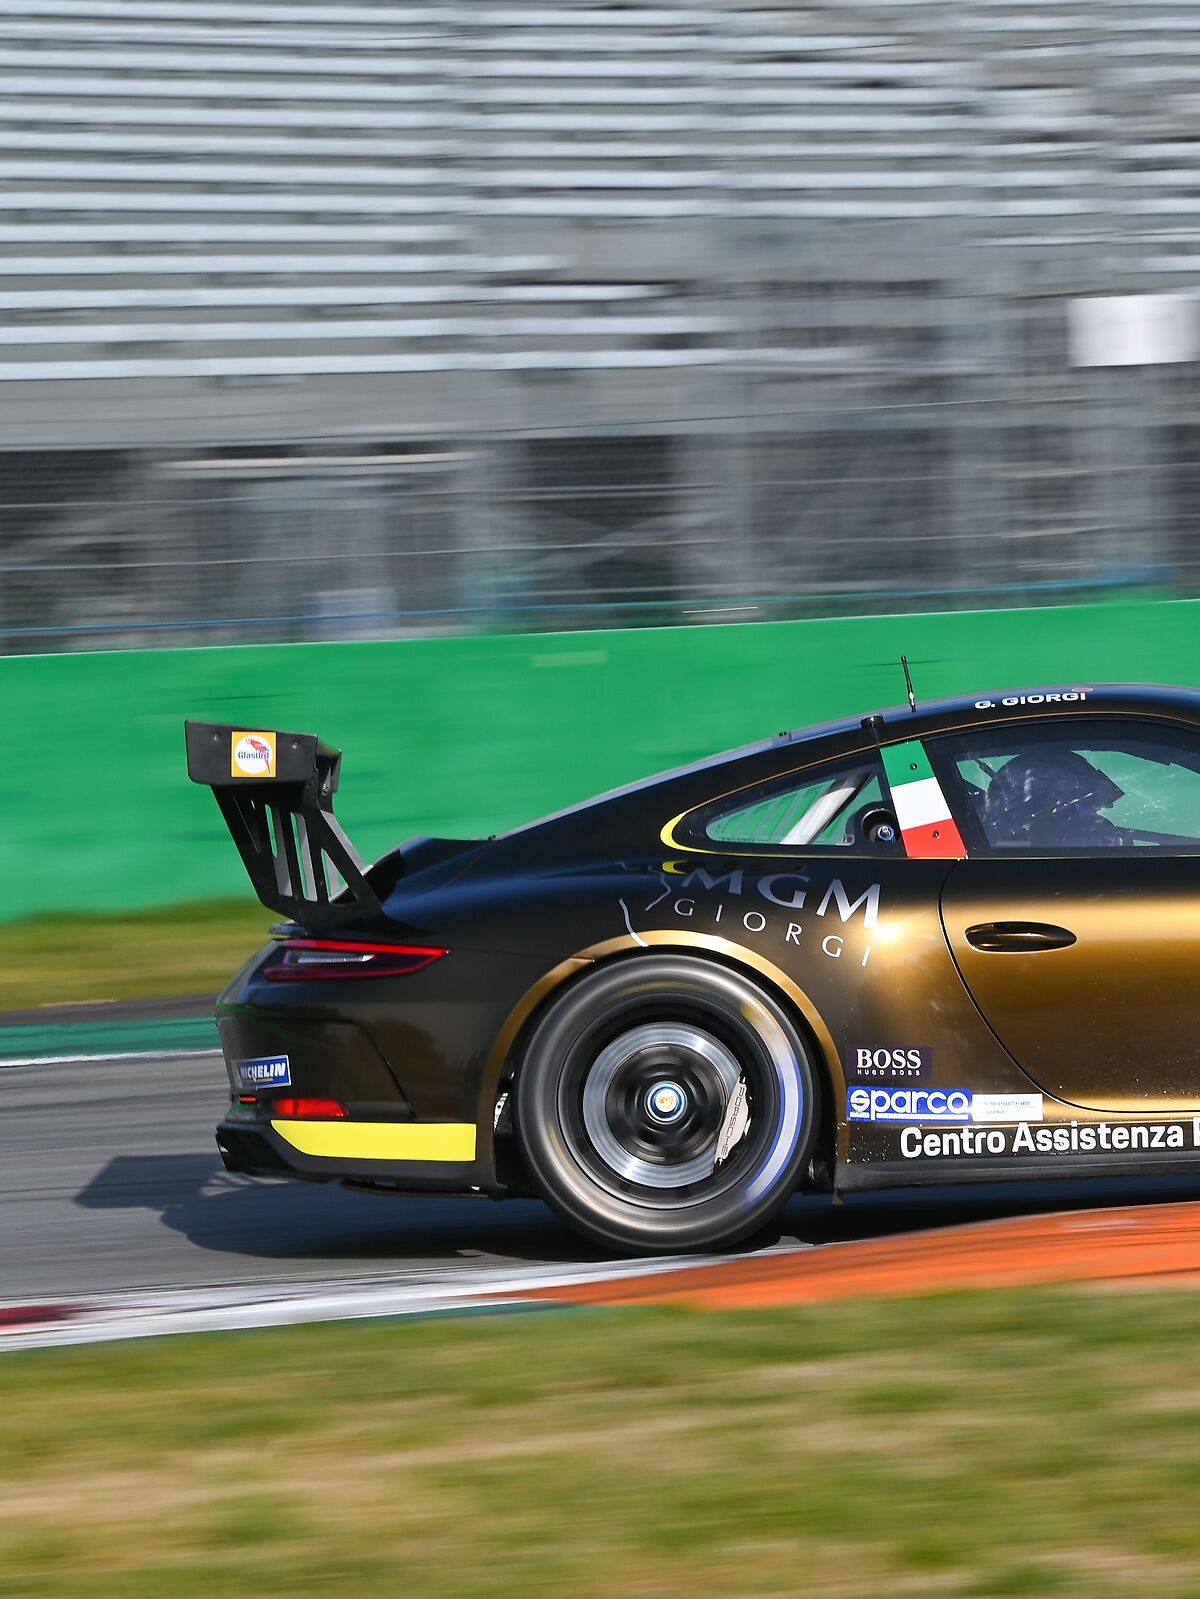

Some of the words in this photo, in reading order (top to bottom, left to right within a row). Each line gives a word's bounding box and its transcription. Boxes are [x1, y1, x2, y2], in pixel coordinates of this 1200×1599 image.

[974, 701, 996, 709] G.
[1001, 692, 1086, 706] GIORGI
[680, 867, 881, 930] MGM
[673, 899, 871, 967] GIORGI
[240, 1062, 287, 1079] MICHELIN
[856, 1048, 922, 1069] BOSS
[721, 1086, 745, 1156] PORSCHE
[850, 1089, 969, 1121] sparco
[900, 1126, 1006, 1159] Centro
[1012, 1120, 1184, 1152] Assistenza
